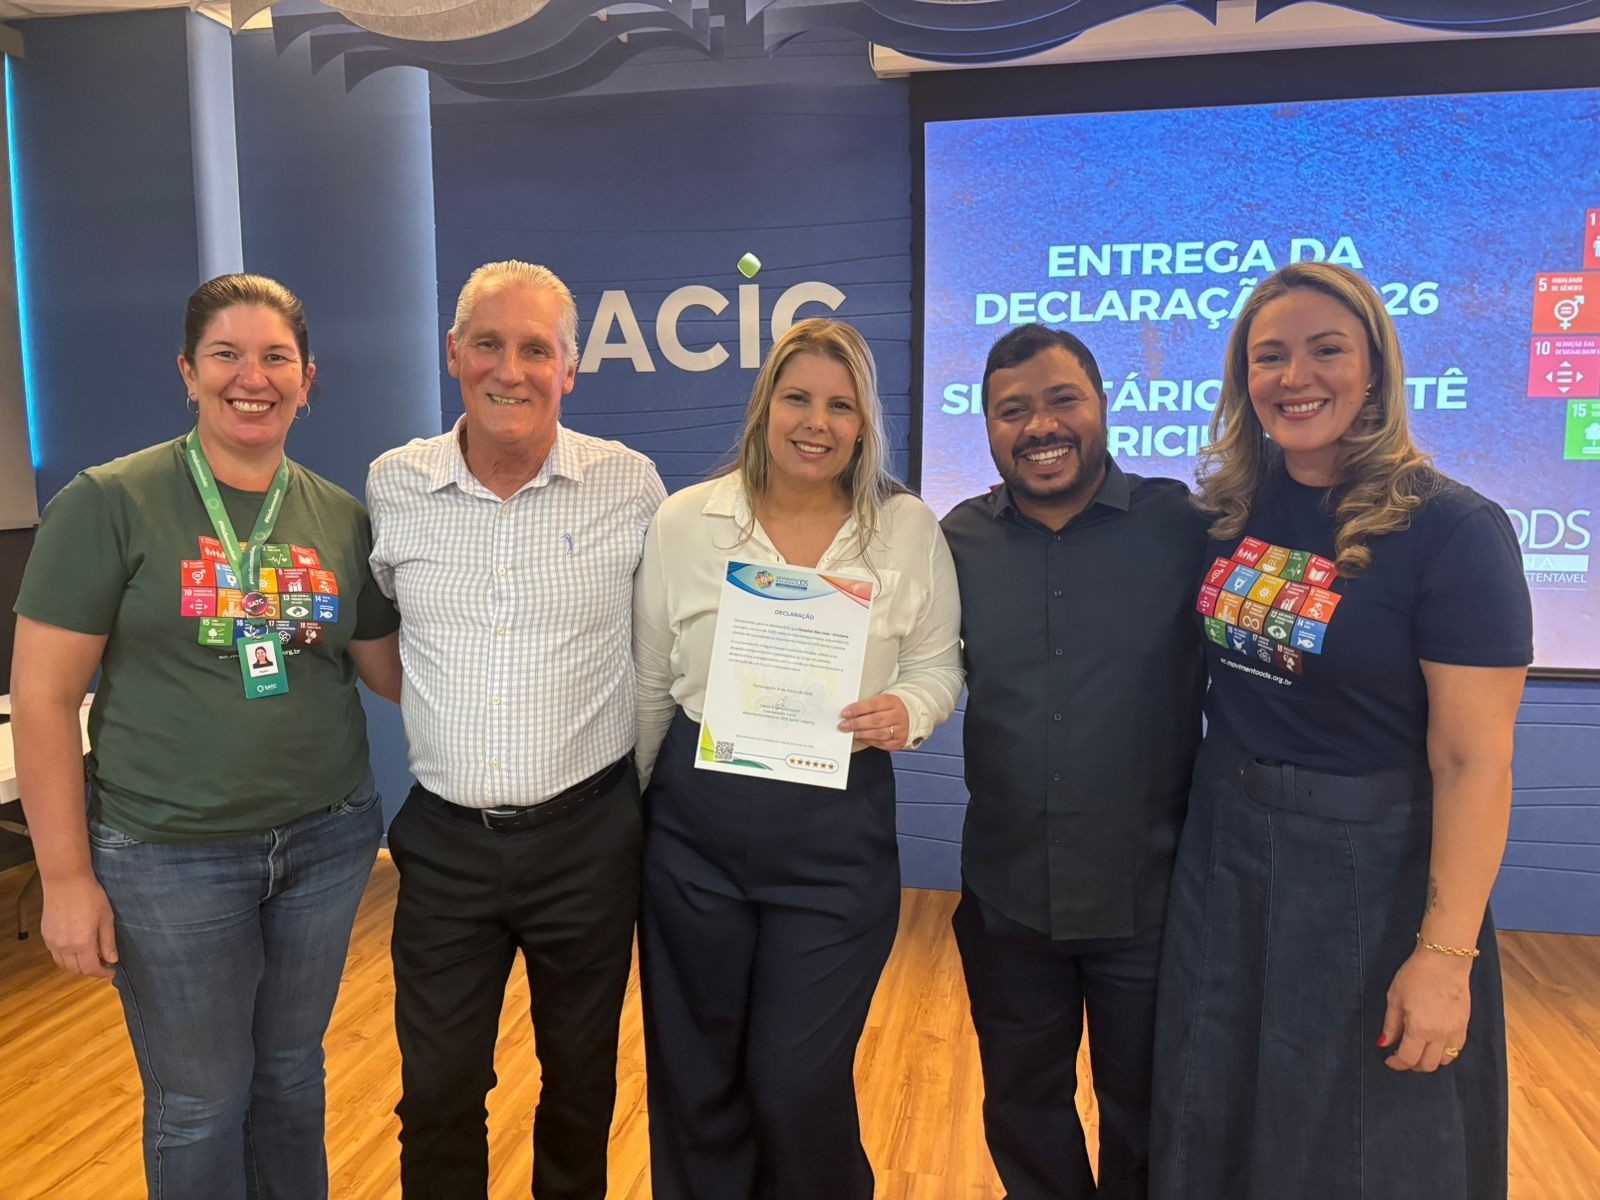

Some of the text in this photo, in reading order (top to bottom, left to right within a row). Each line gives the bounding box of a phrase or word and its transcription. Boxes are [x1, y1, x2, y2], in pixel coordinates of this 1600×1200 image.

[1590, 213, 1596, 226] 1
[1049, 236, 1364, 277] ENTREGA DA
[1539, 278, 1548, 292] 5
[975, 277, 1439, 329] DECLARAÇÃ 26
[1535, 341, 1551, 355] 10
[1572, 403, 1587, 417] 15
[247, 598, 264, 607] SATC
[775, 609, 815, 620] DECLARAÇÃO
[203, 618, 210, 626] 15
